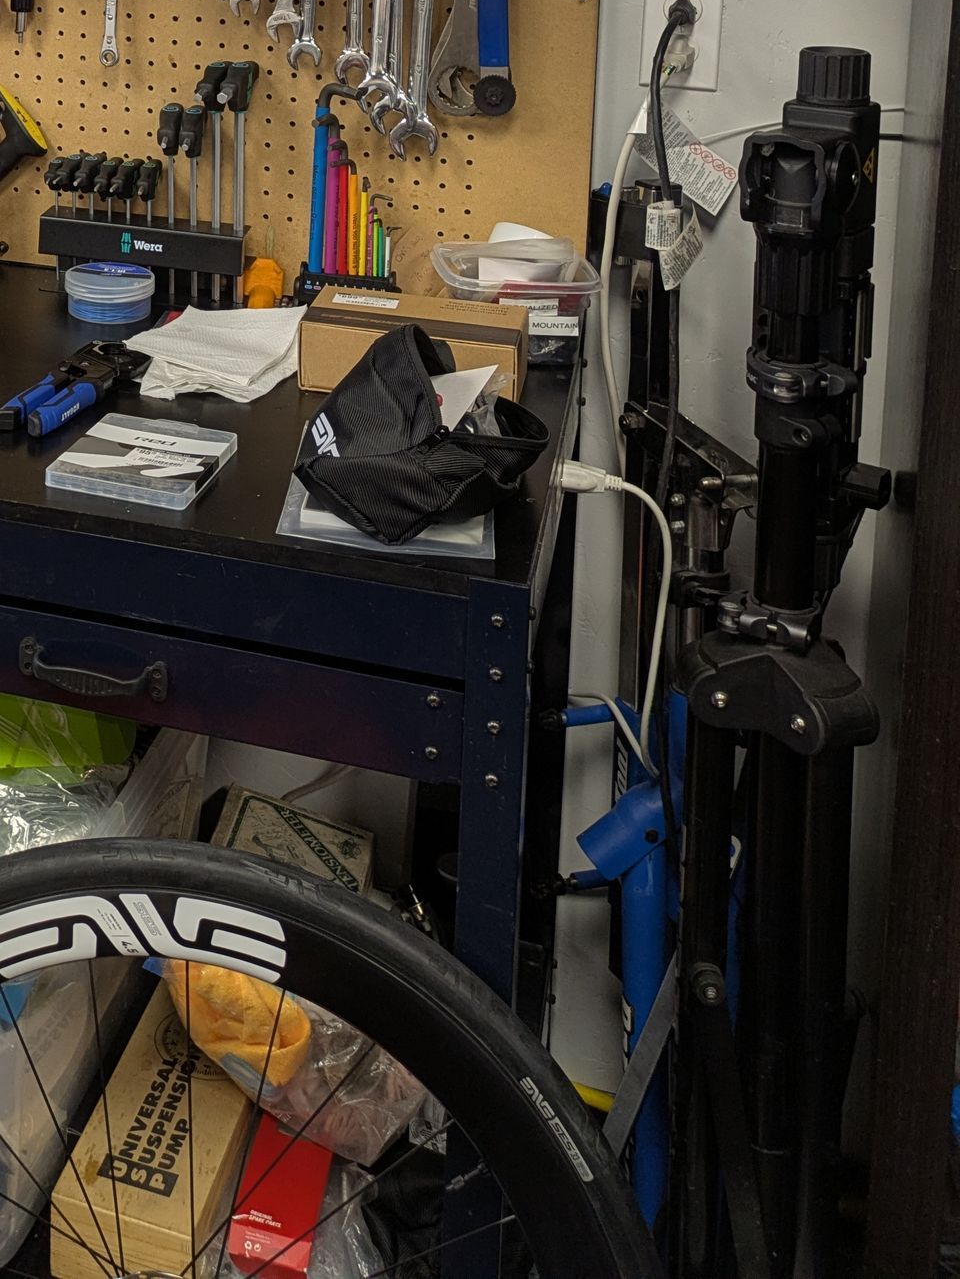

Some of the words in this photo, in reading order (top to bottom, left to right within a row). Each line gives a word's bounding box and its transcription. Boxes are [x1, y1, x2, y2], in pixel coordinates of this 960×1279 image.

[134, 240, 163, 253] Wera
[121, 941, 139, 953] 4.5
[149, 1118, 190, 1190] PUMP
